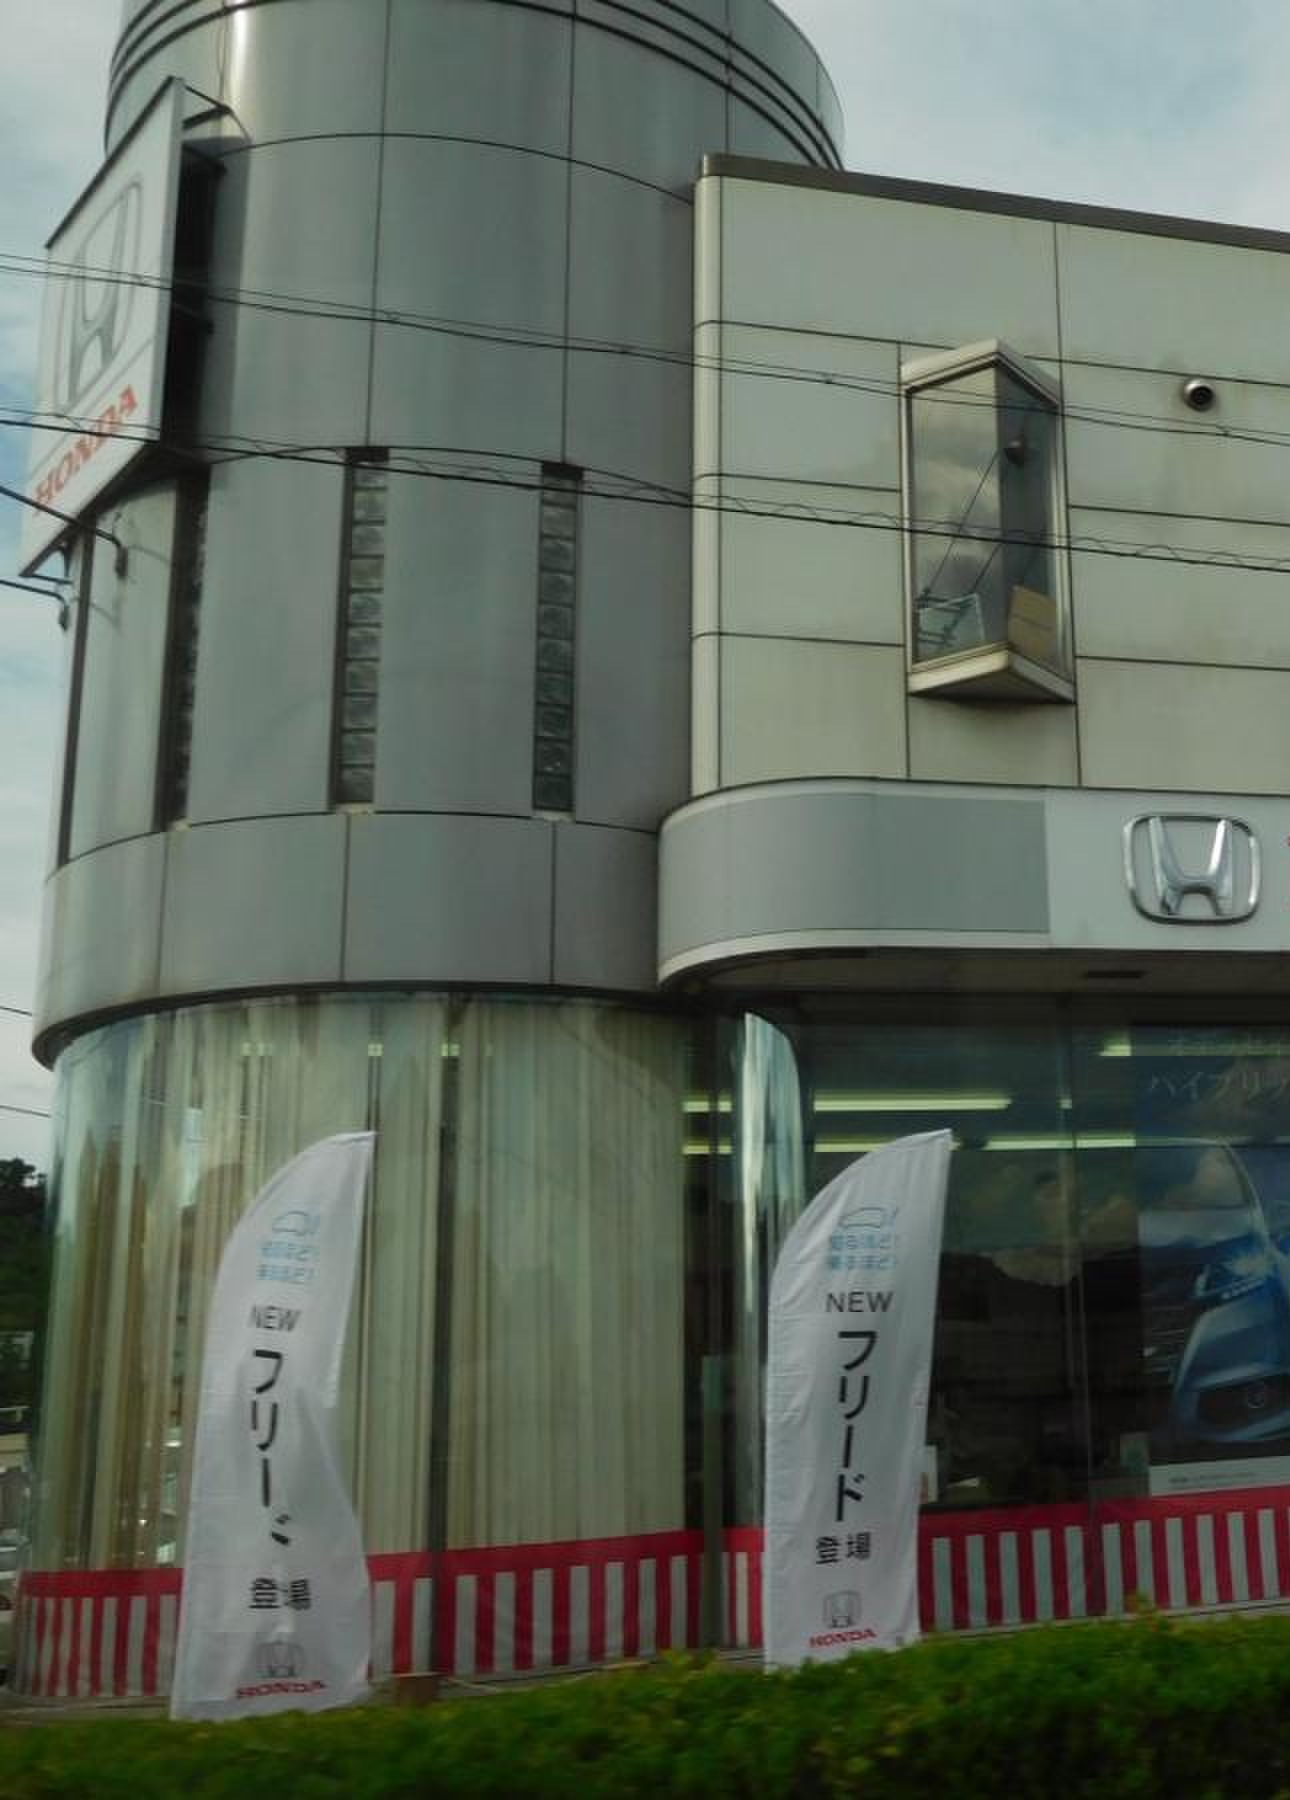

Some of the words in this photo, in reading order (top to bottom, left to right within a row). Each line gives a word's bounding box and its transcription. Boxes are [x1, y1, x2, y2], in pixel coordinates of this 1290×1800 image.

[35, 386, 138, 512] HONDA
[825, 1291, 894, 1313] NEW
[247, 1304, 302, 1331] NEW
[835, 1330, 878, 1521] フリード
[809, 1628, 877, 1648] HONDA
[236, 1680, 327, 1699] HONDA
